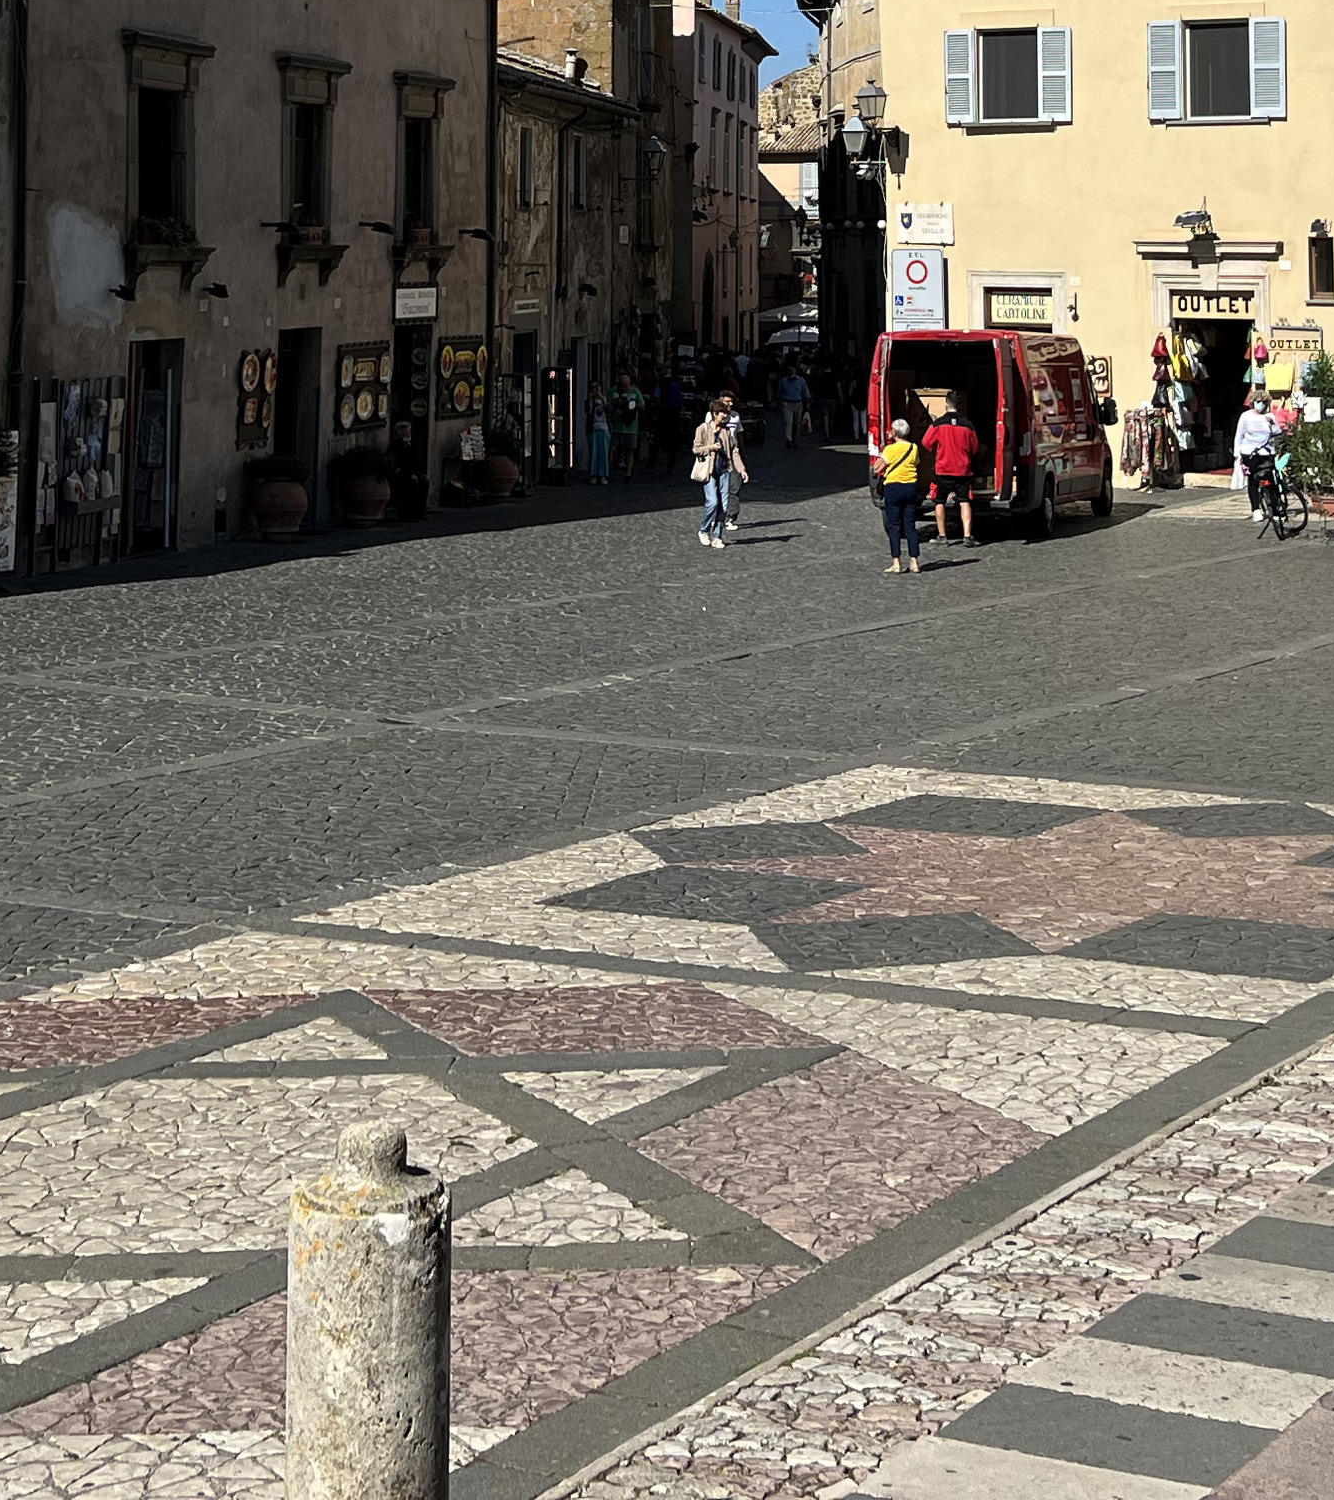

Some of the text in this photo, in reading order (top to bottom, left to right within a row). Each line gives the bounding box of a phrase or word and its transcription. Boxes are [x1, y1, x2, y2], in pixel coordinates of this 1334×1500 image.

[1178, 296, 1251, 313] OUTLET
[996, 307, 1049, 320] CARTOLINE
[1269, 339, 1319, 349] OUTLET
